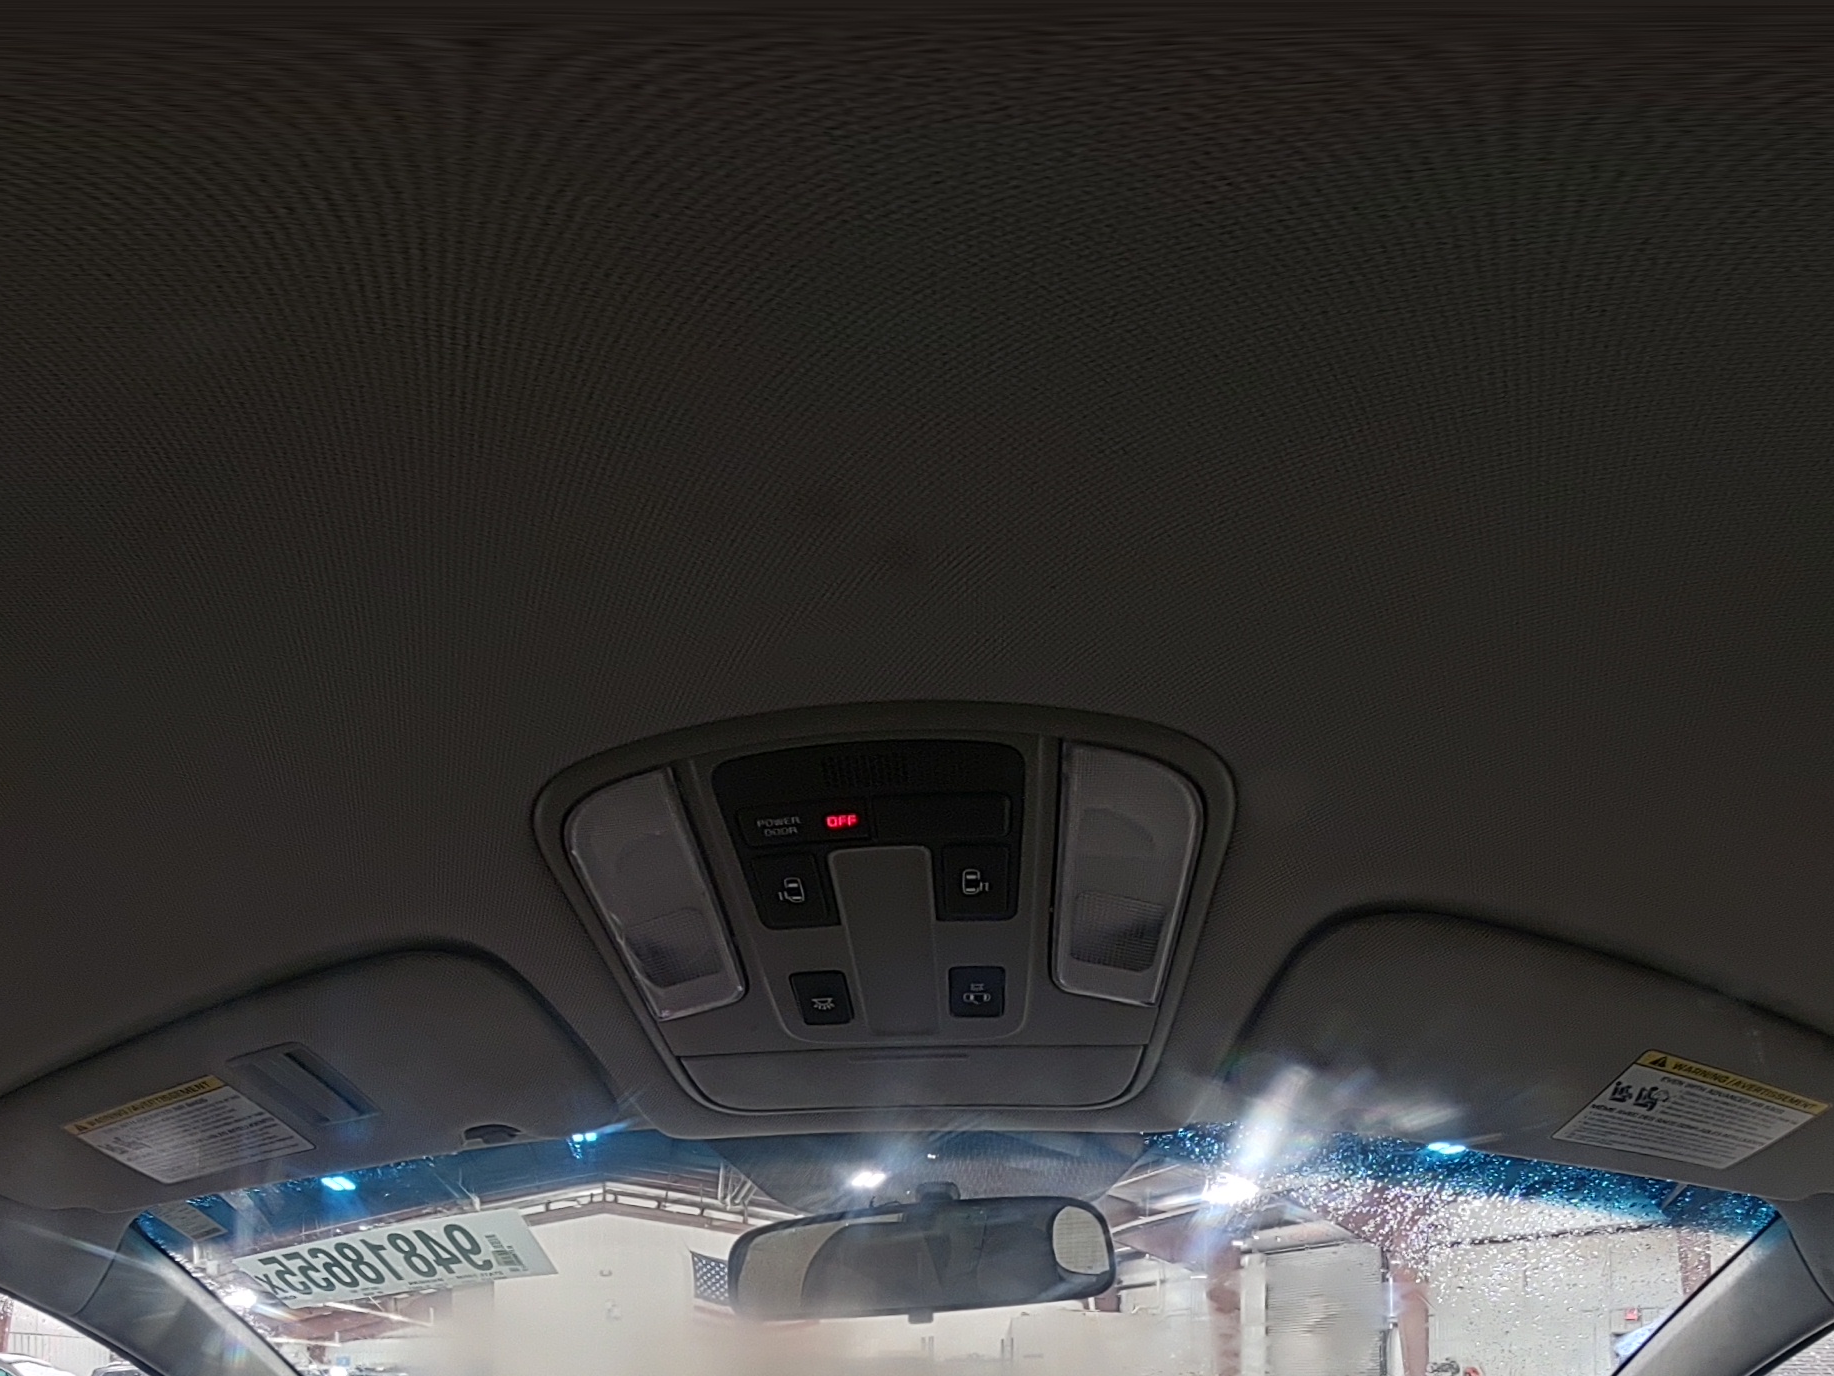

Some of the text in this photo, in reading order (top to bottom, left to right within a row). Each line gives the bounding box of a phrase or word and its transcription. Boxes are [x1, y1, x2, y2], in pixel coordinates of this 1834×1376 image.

[757, 816, 801, 828] POWER
[826, 814, 857, 828] OFF
[764, 826, 798, 837] DOOR
[1672, 1061, 1729, 1084] WARNING
[1732, 1078, 1817, 1111] AVERTISSEMENT
